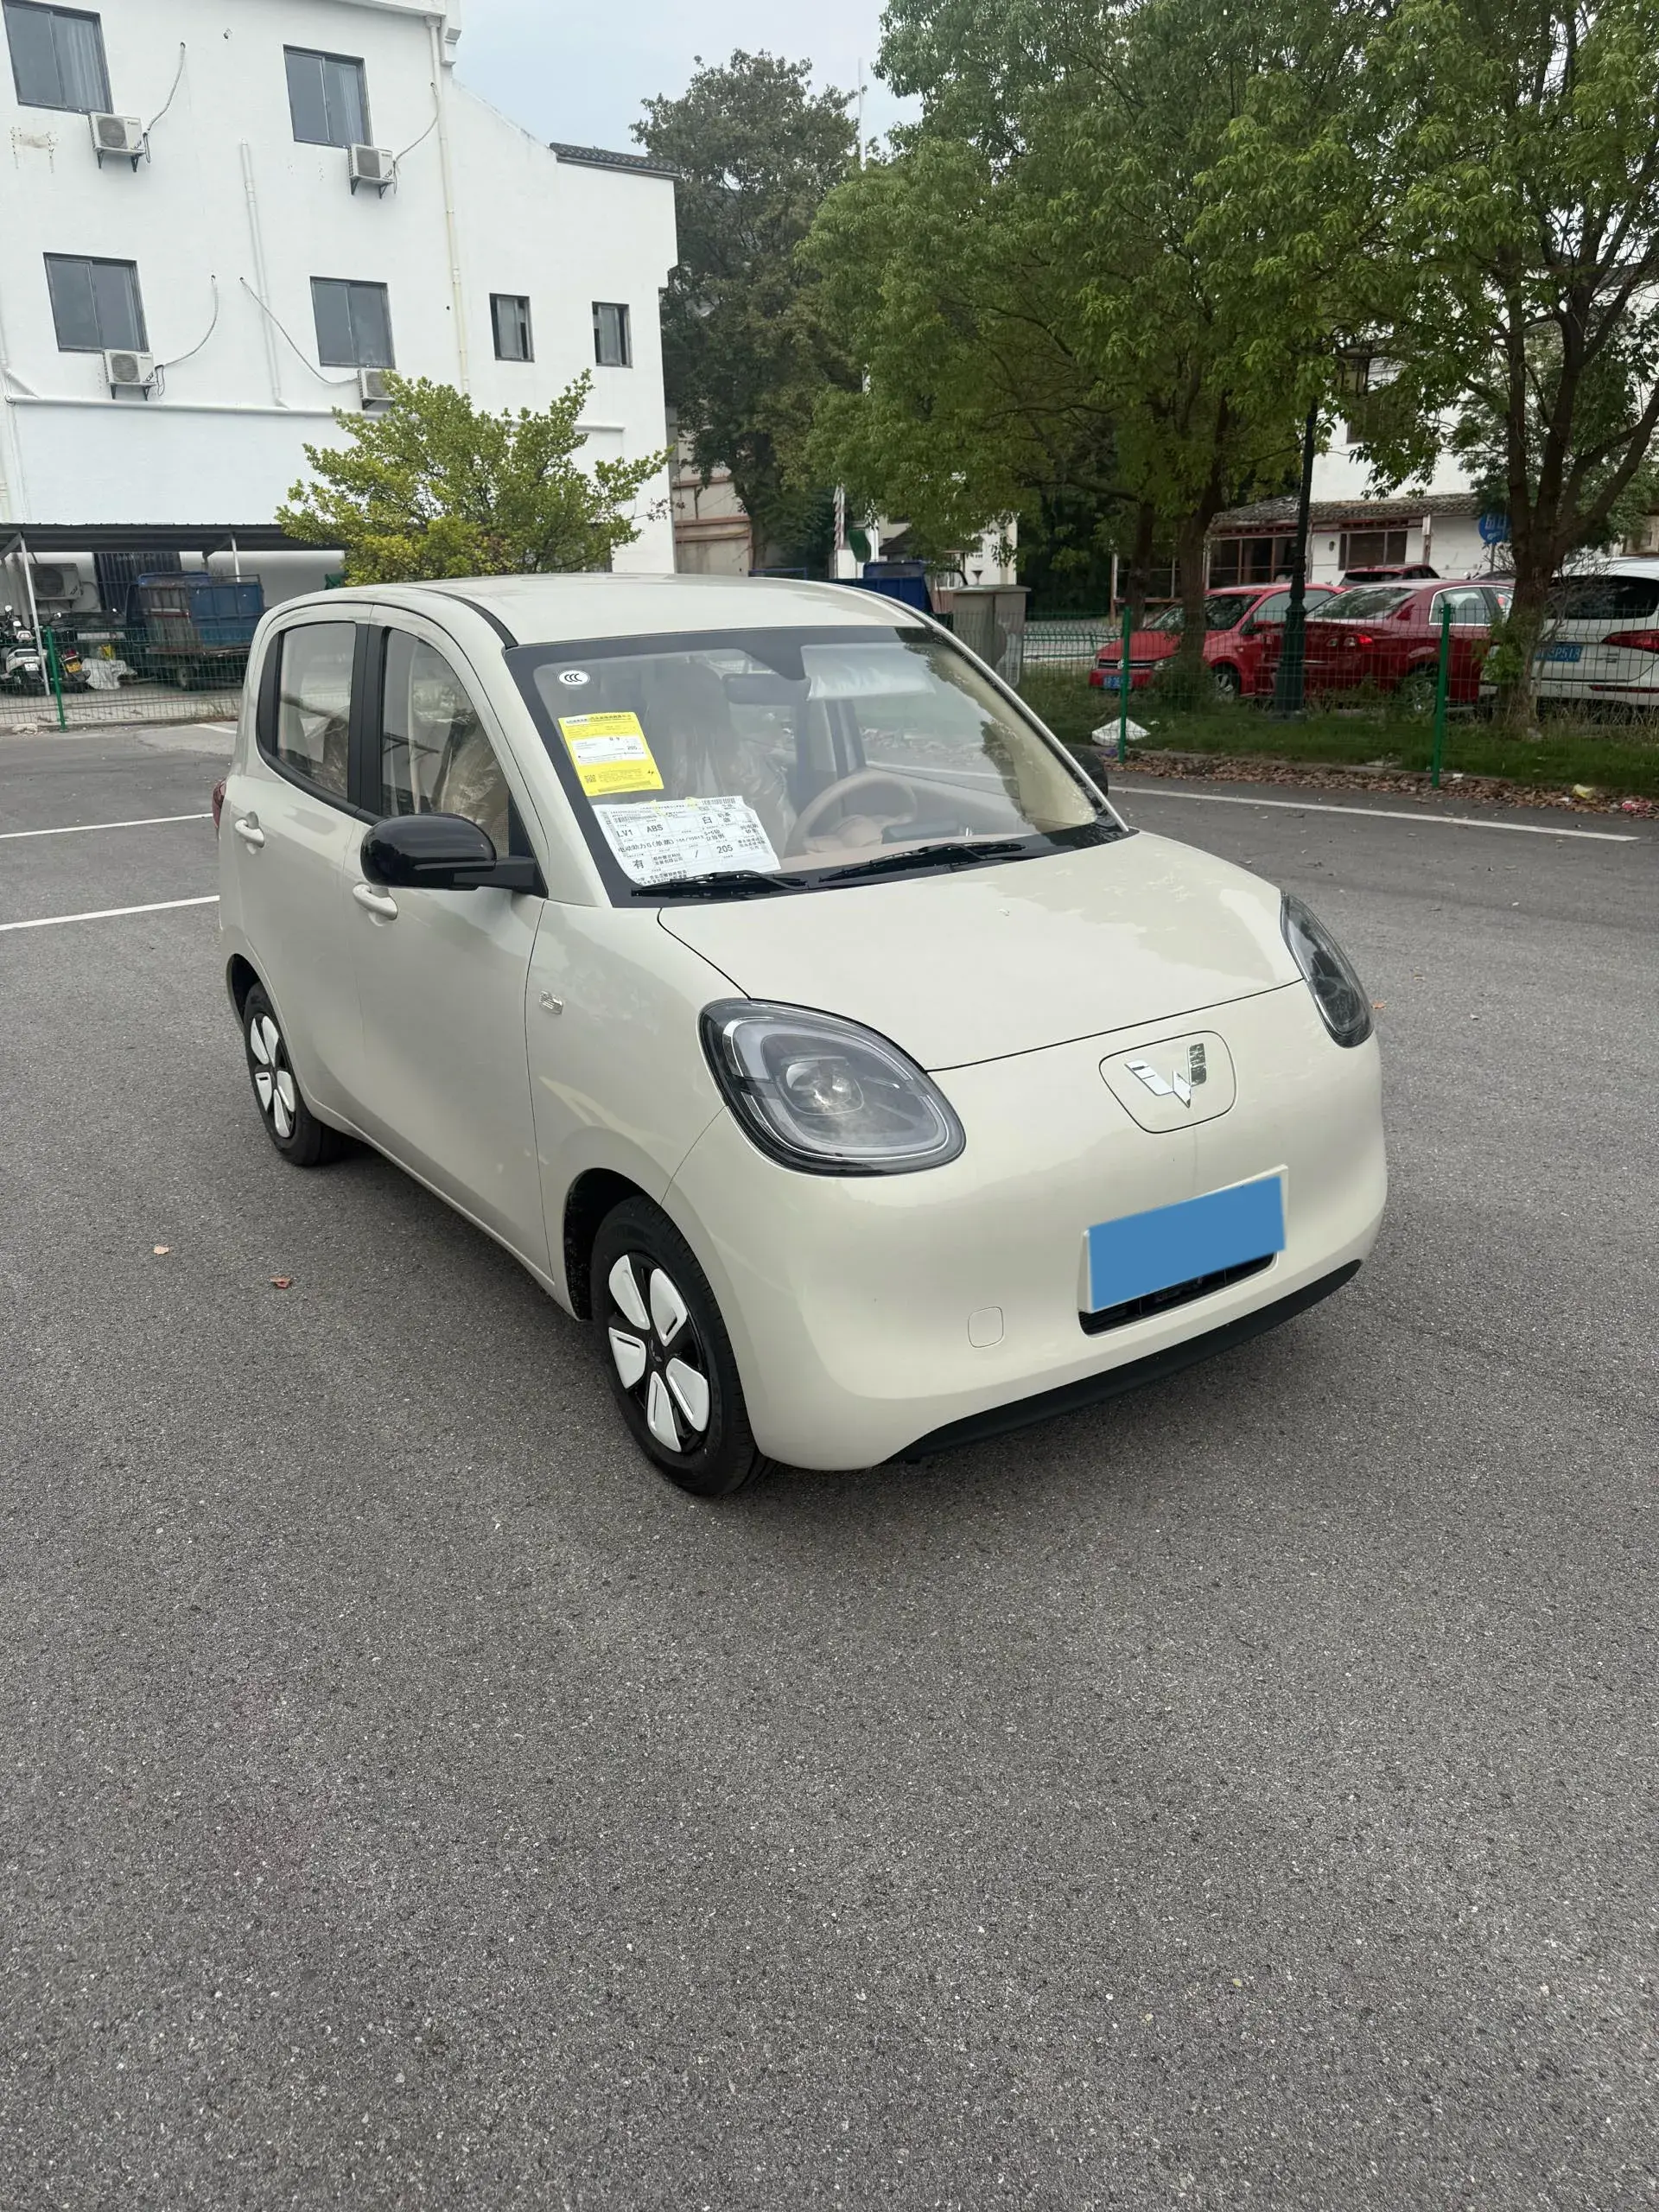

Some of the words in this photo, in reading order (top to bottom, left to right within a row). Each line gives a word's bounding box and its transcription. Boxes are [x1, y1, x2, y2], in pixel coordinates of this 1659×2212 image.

[702, 816, 713, 824] 白
[646, 824, 664, 833] ABS
[716, 844, 734, 854] 205
[632, 860, 644, 869] 有
